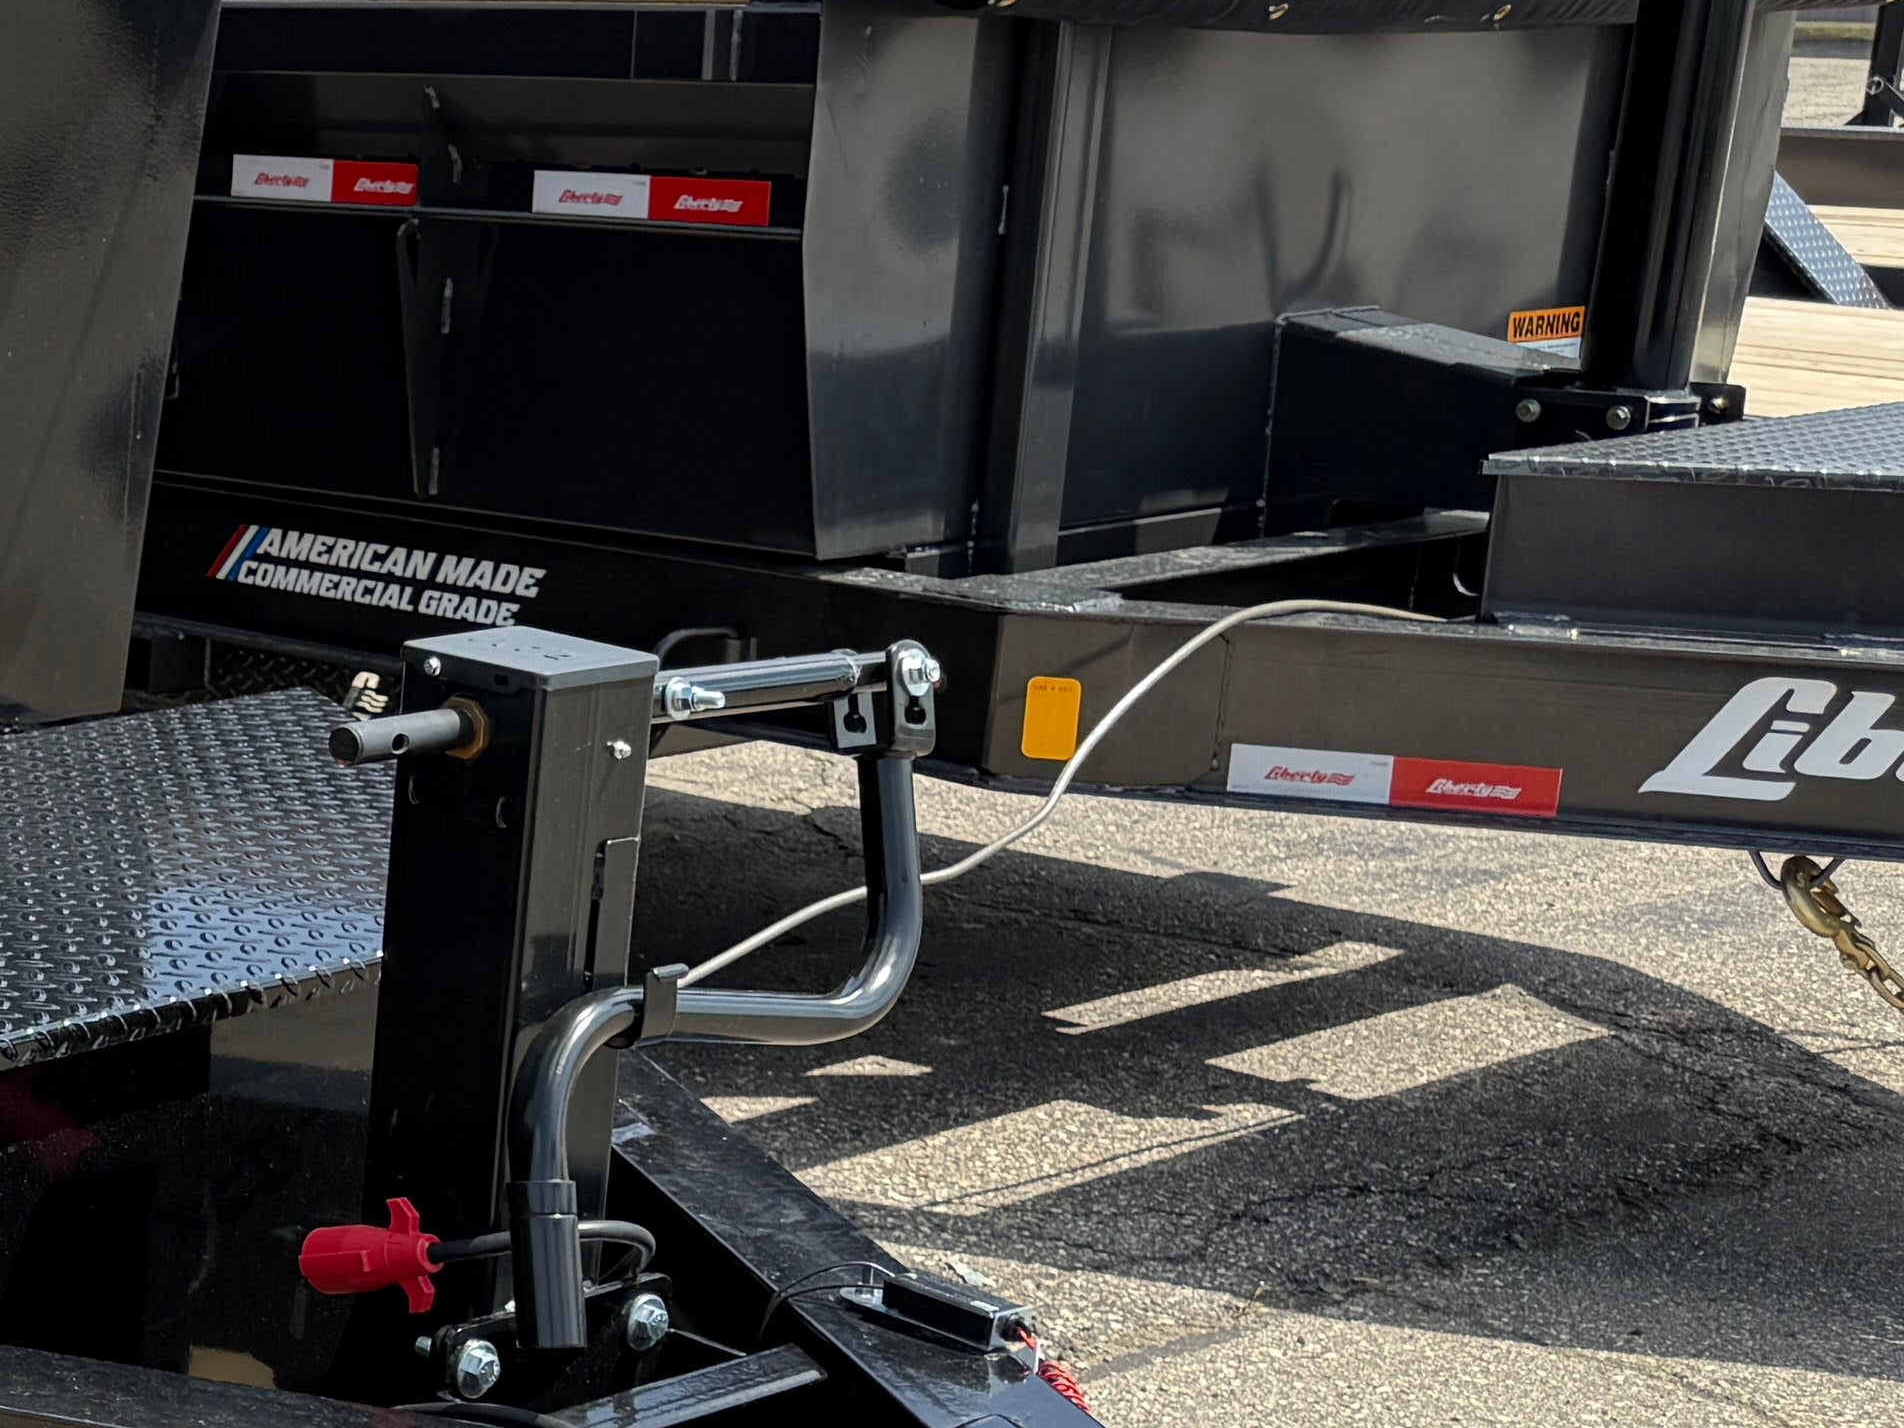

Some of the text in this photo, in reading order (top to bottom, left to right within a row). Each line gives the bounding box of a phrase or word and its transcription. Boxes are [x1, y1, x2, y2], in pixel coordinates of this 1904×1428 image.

[1513, 312, 1581, 339] WARNING
[238, 560, 521, 627] COMMERCIAL GRADE
[256, 528, 547, 598] AMERICAN MADE
[1637, 677, 1904, 802] Lib
